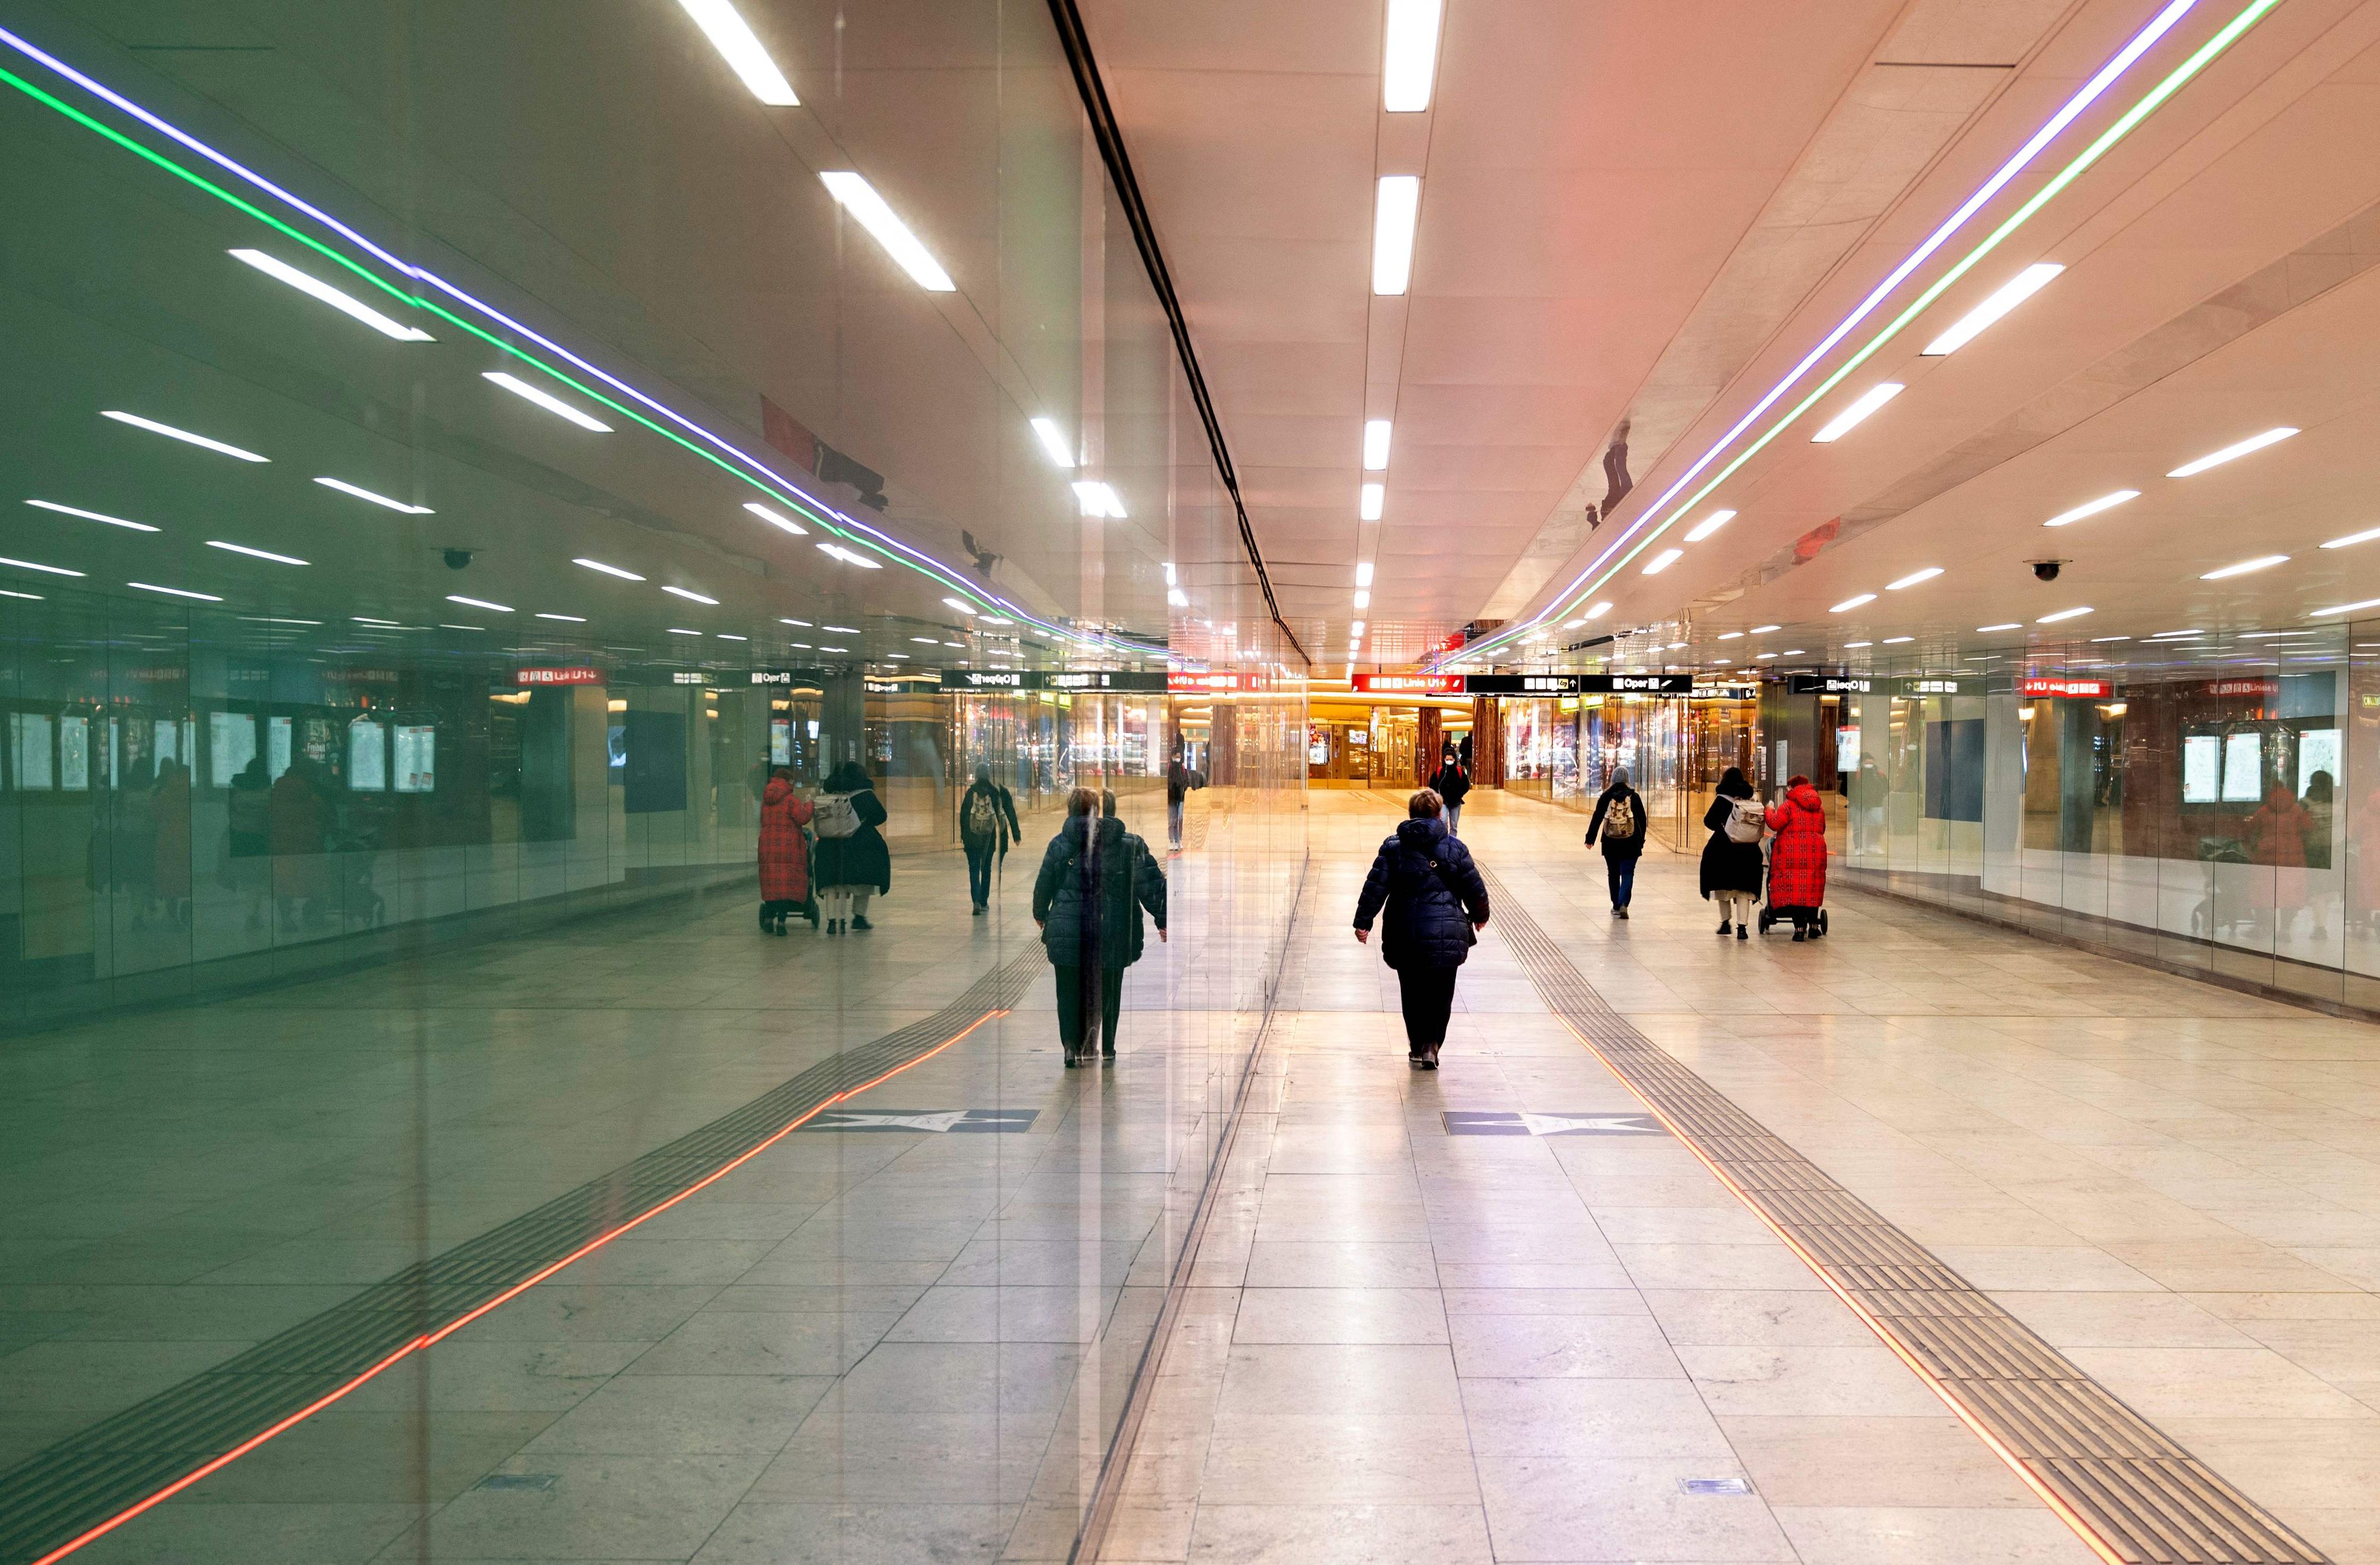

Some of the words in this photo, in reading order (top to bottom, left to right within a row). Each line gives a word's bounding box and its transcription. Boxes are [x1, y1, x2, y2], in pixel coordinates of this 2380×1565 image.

[1404, 678, 1426, 687] Linie
[1428, 678, 1439, 687] U1
[1624, 678, 1648, 689] Oper
